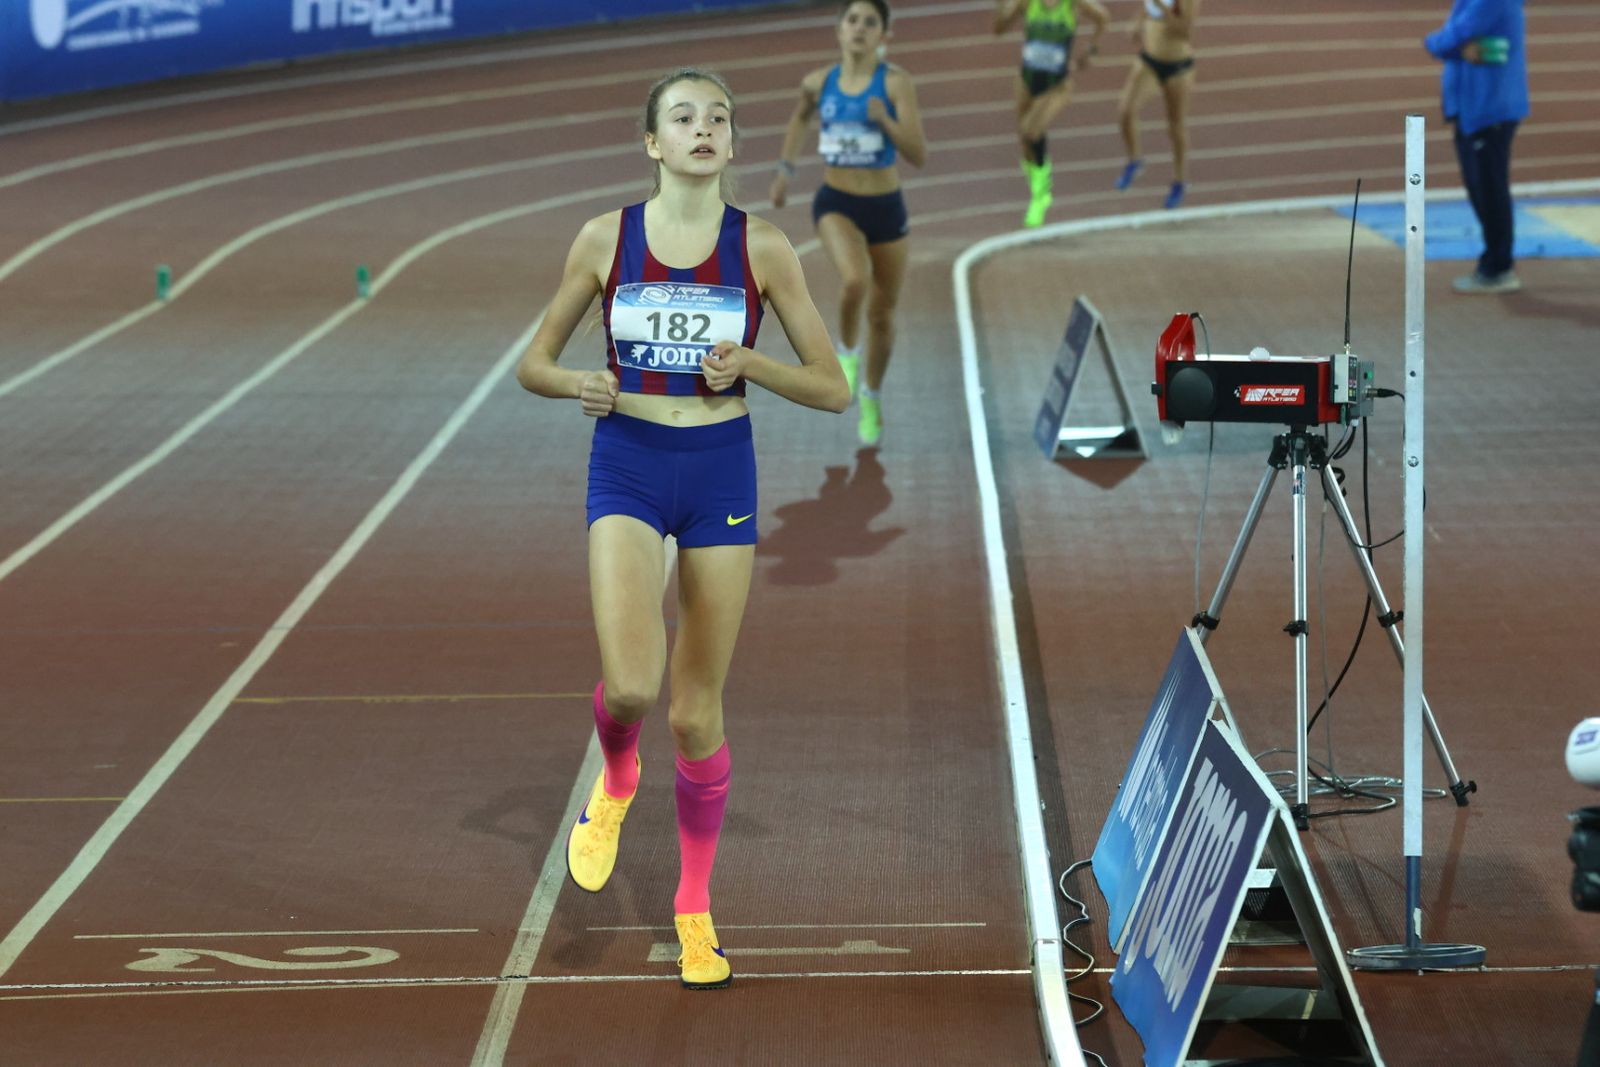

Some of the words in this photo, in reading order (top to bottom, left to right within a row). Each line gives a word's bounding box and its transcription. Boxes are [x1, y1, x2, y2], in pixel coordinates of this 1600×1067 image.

[646, 312, 711, 343] 182
[647, 346, 720, 367] Jom
[1124, 757, 1248, 1013] Joma
[124, 946, 401, 973] 2
